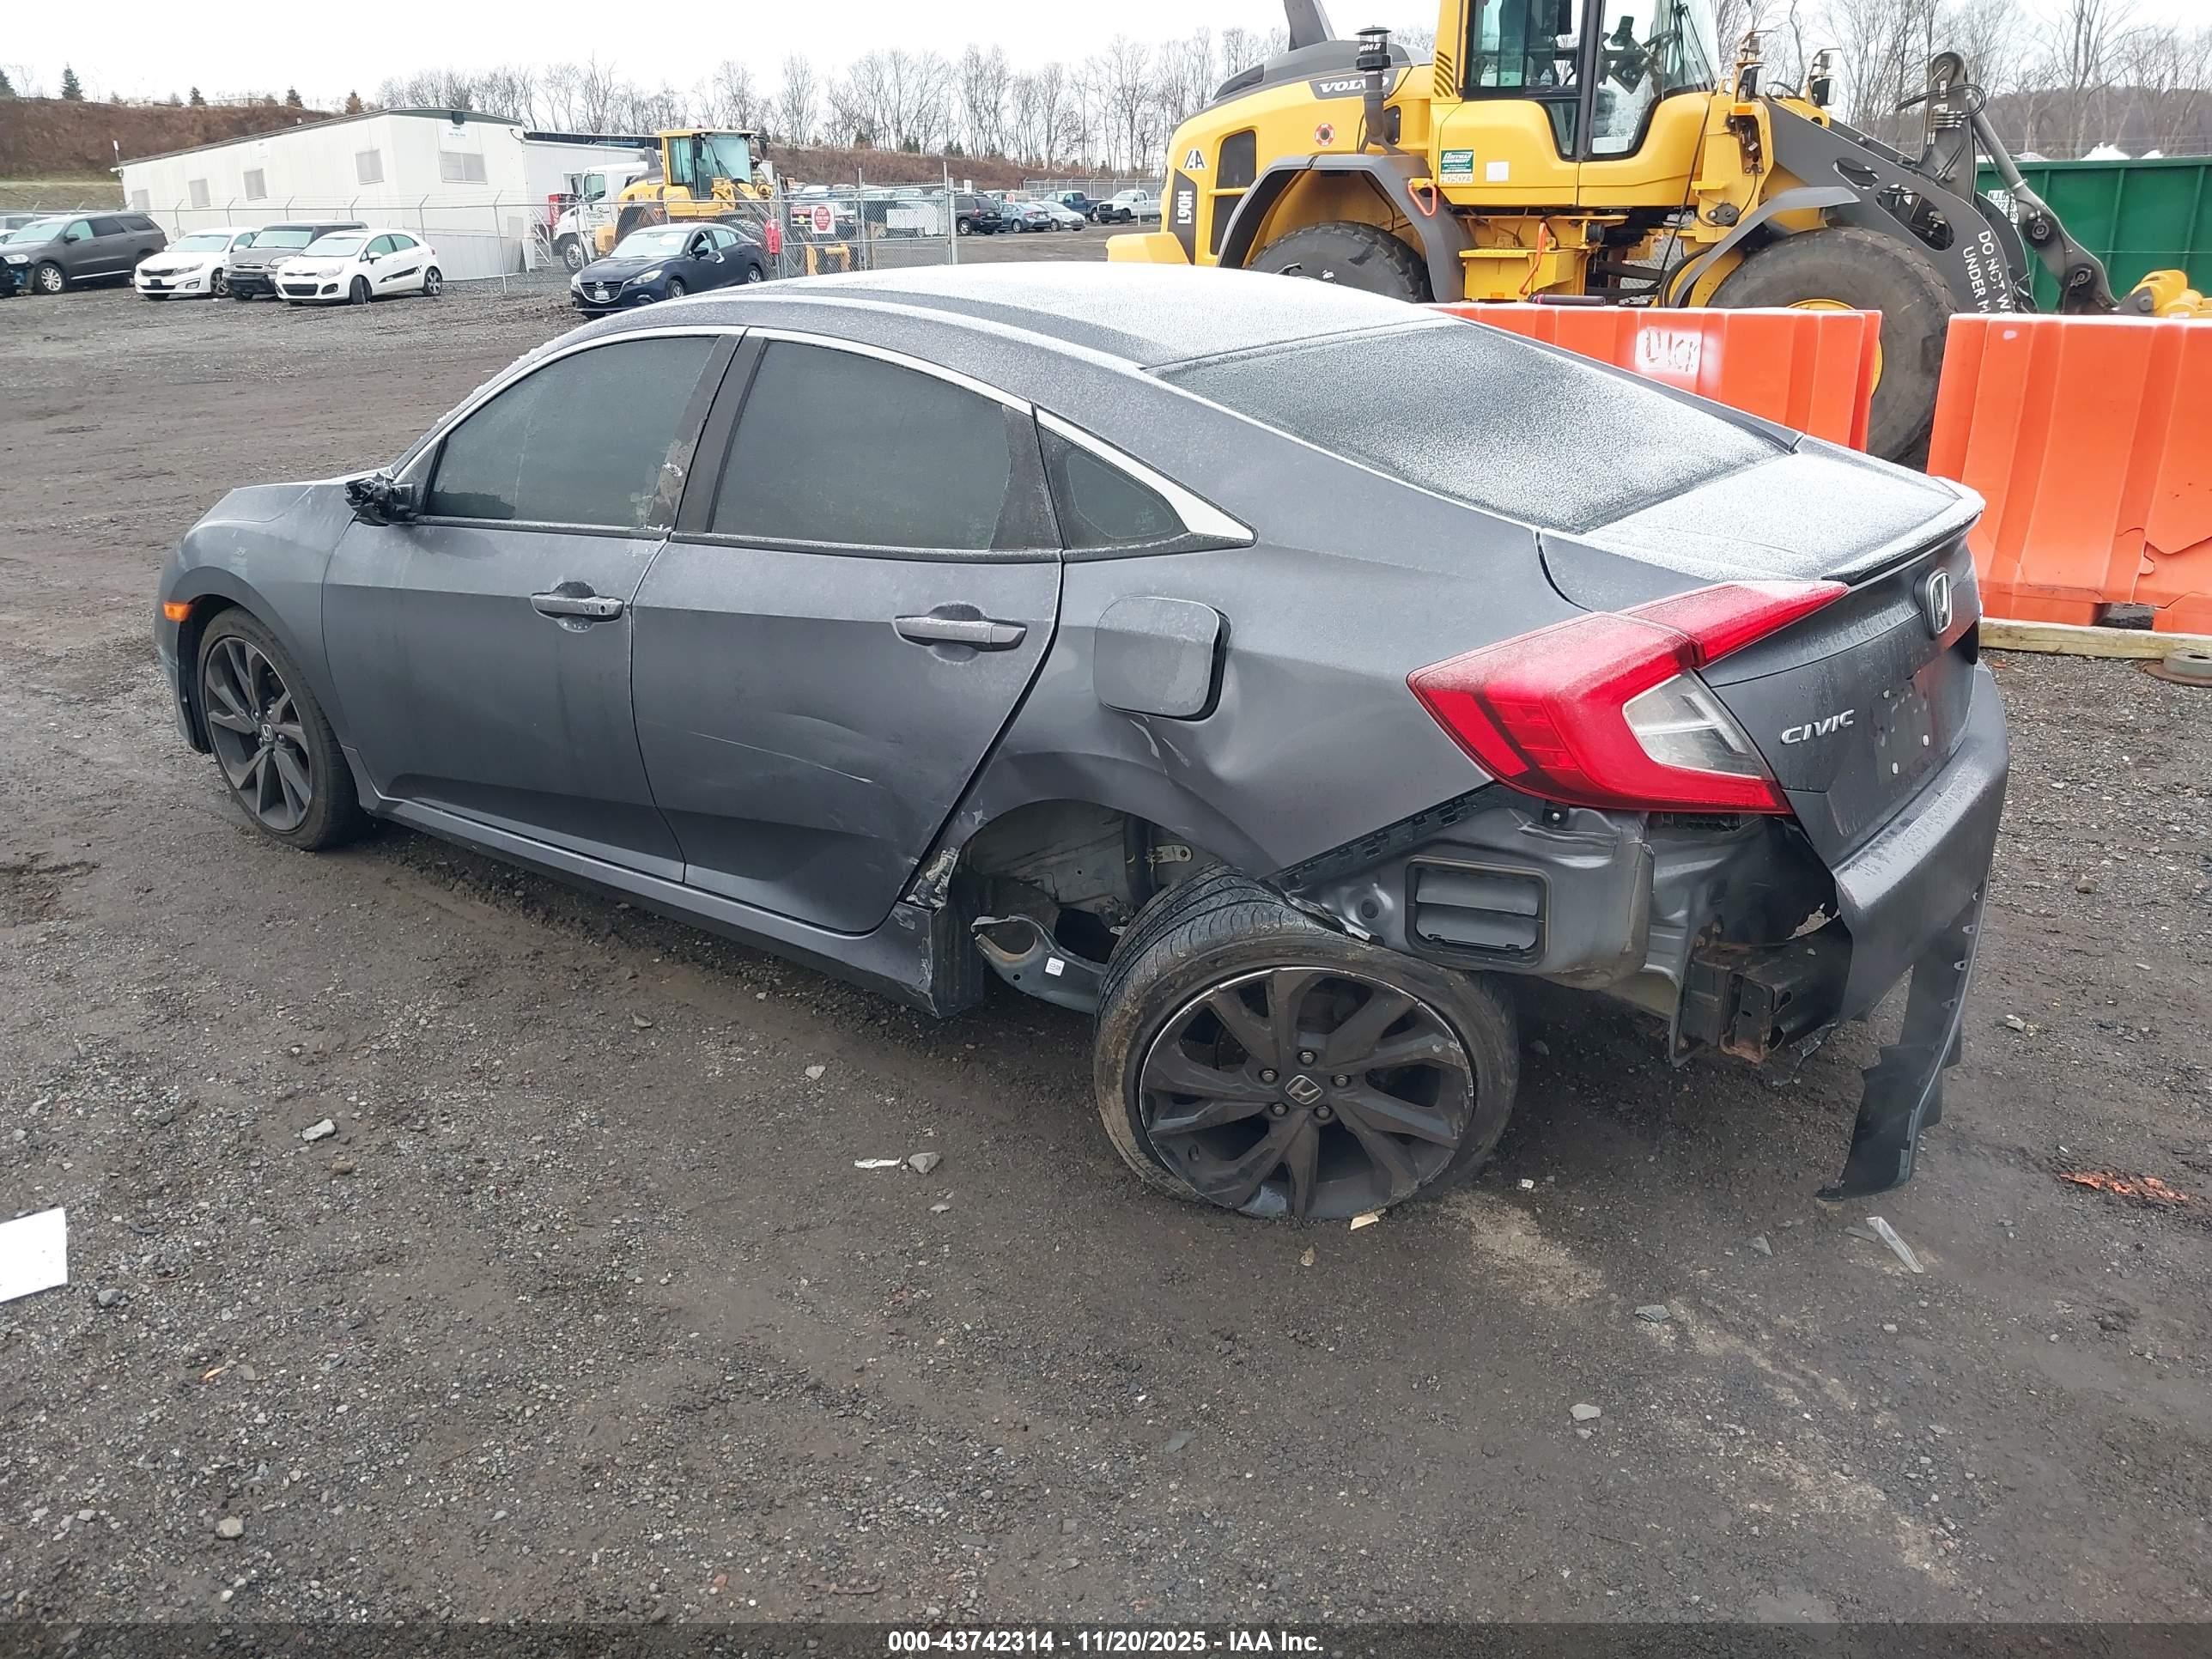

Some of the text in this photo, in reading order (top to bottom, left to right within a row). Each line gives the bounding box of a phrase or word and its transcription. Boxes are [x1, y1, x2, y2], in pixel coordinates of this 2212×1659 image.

[1176, 191, 1193, 224] L90H
[1978, 229, 1995, 256] DO
[1962, 246, 1986, 299] UNDER
[1984, 258, 2006, 291] NOT
[1781, 708, 1855, 744] CIVIC
